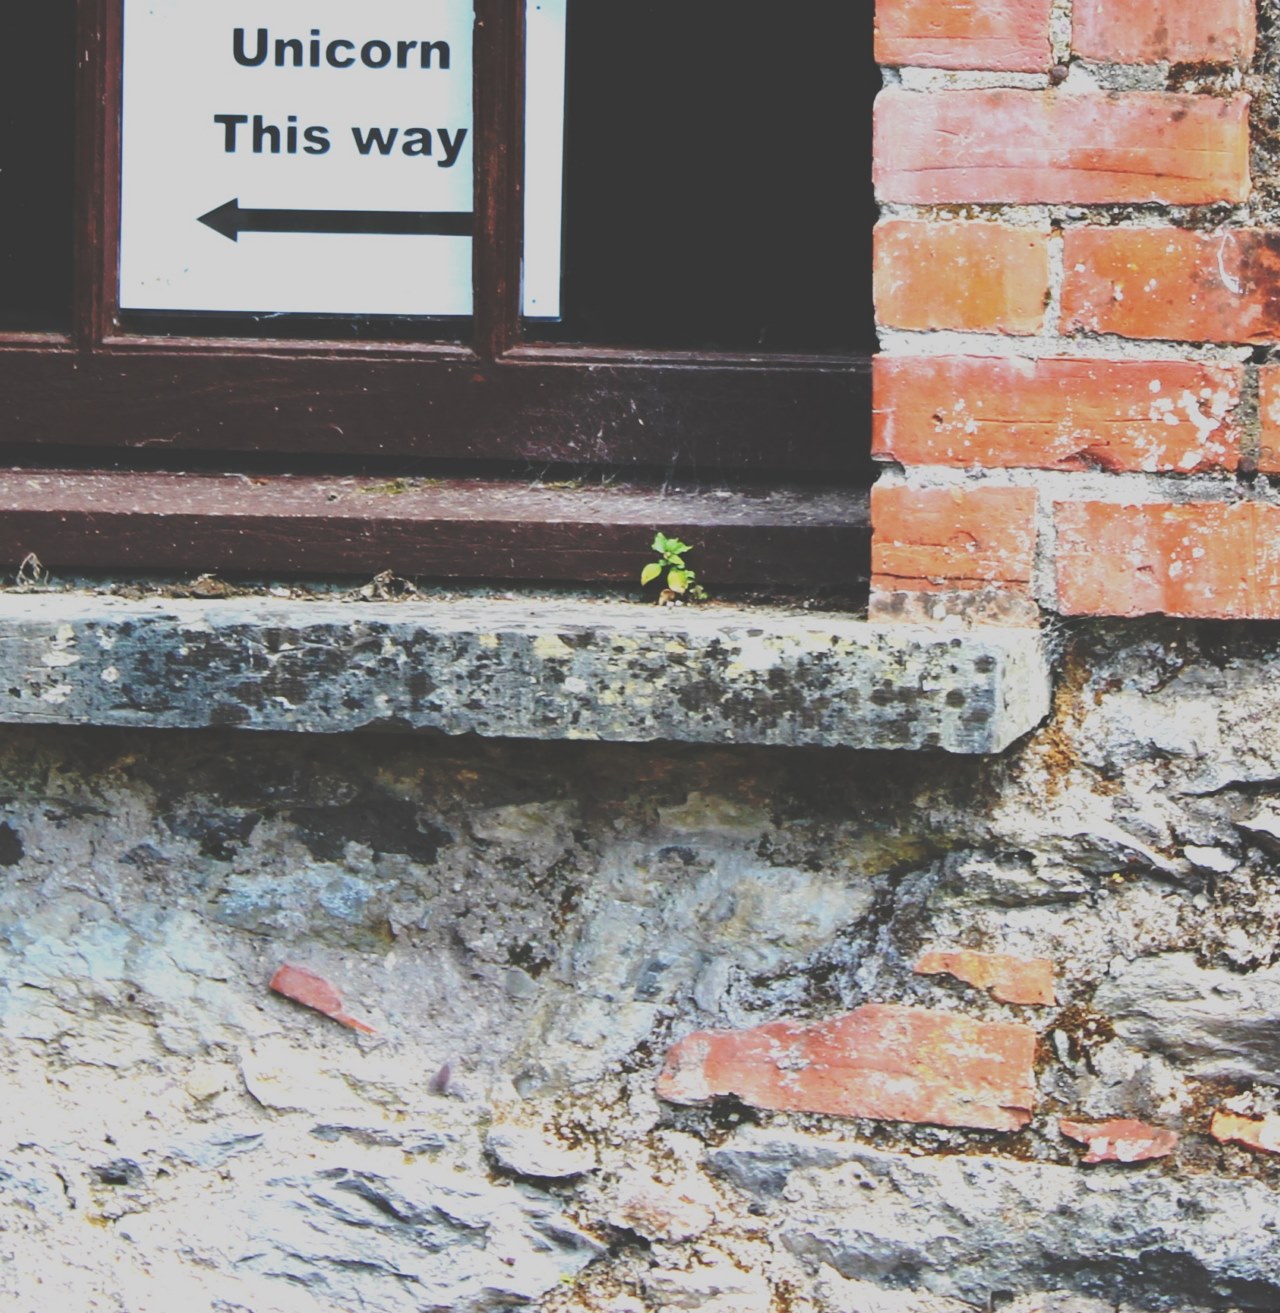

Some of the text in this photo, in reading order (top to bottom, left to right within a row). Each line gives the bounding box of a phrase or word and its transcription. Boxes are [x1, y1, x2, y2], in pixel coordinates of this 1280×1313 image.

[232, 27, 452, 70] Unicorn
[213, 114, 469, 168] This way
